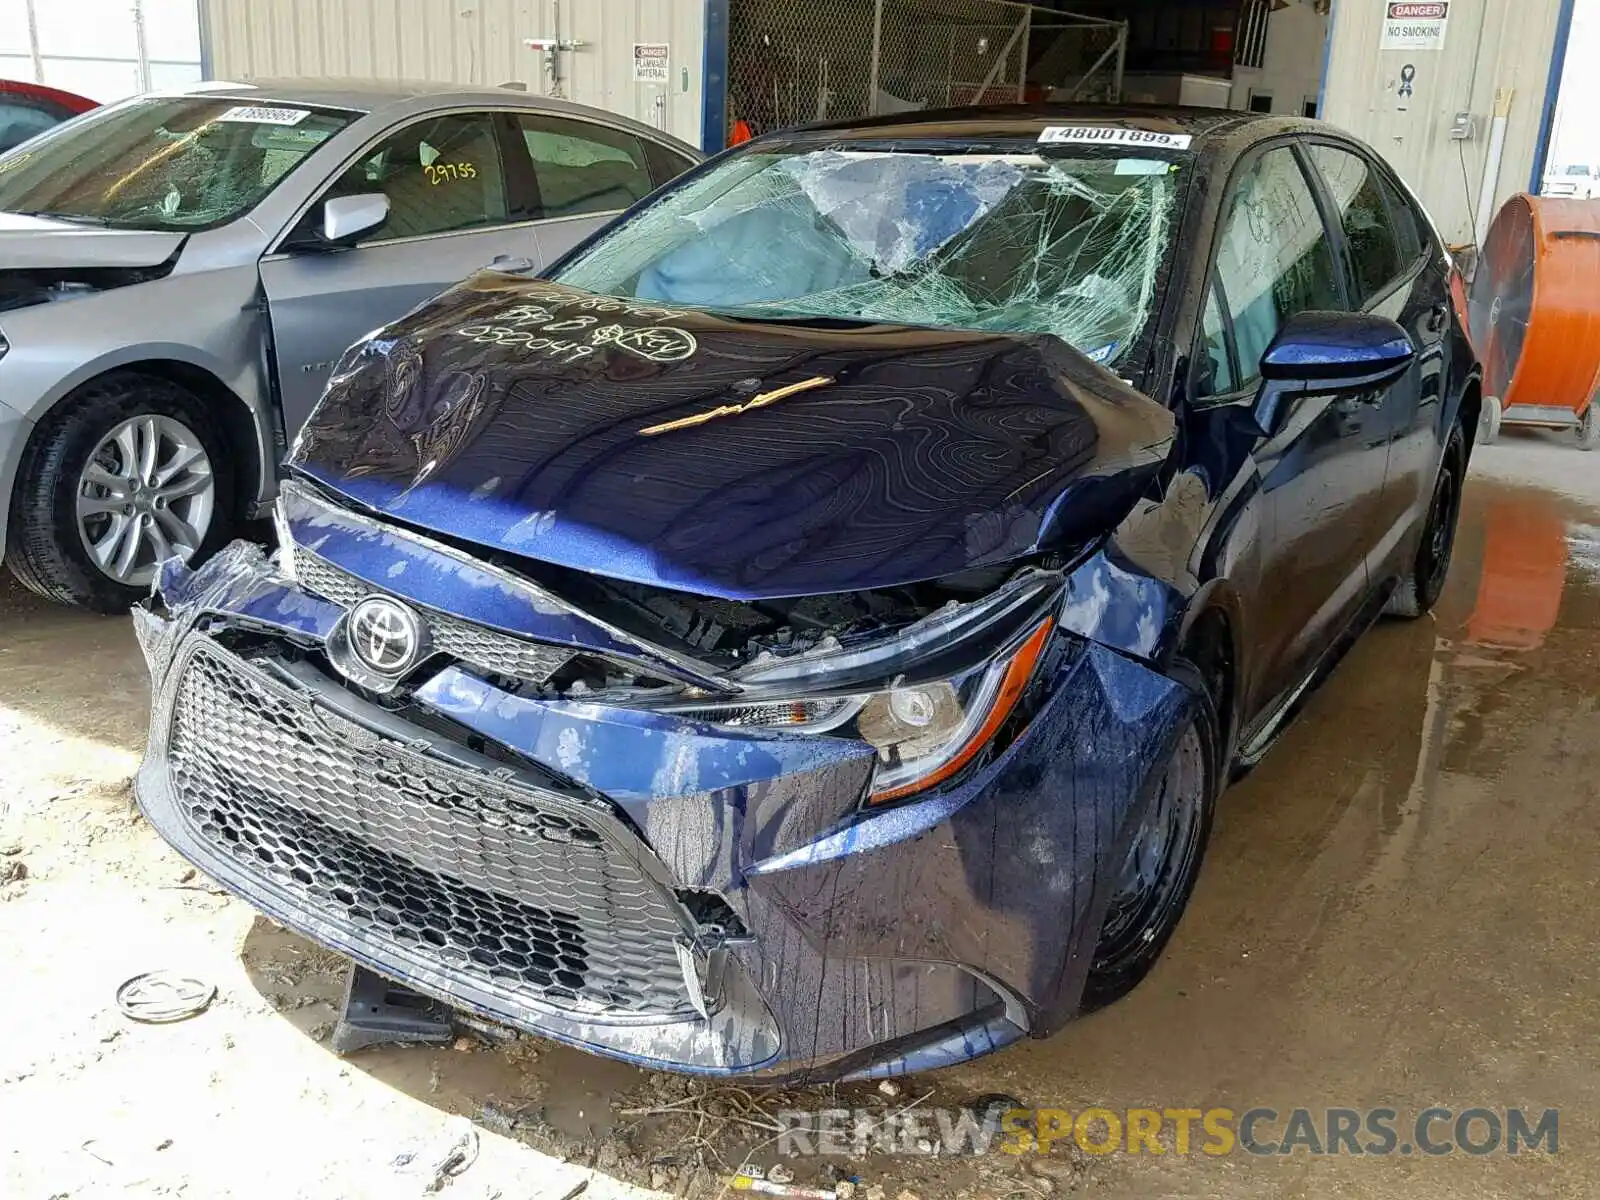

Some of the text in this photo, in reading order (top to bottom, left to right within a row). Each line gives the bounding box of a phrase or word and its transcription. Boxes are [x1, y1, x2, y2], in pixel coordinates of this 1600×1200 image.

[1395, 6, 1441, 16] DANGER
[1388, 26, 1441, 37] NO SMOKING
